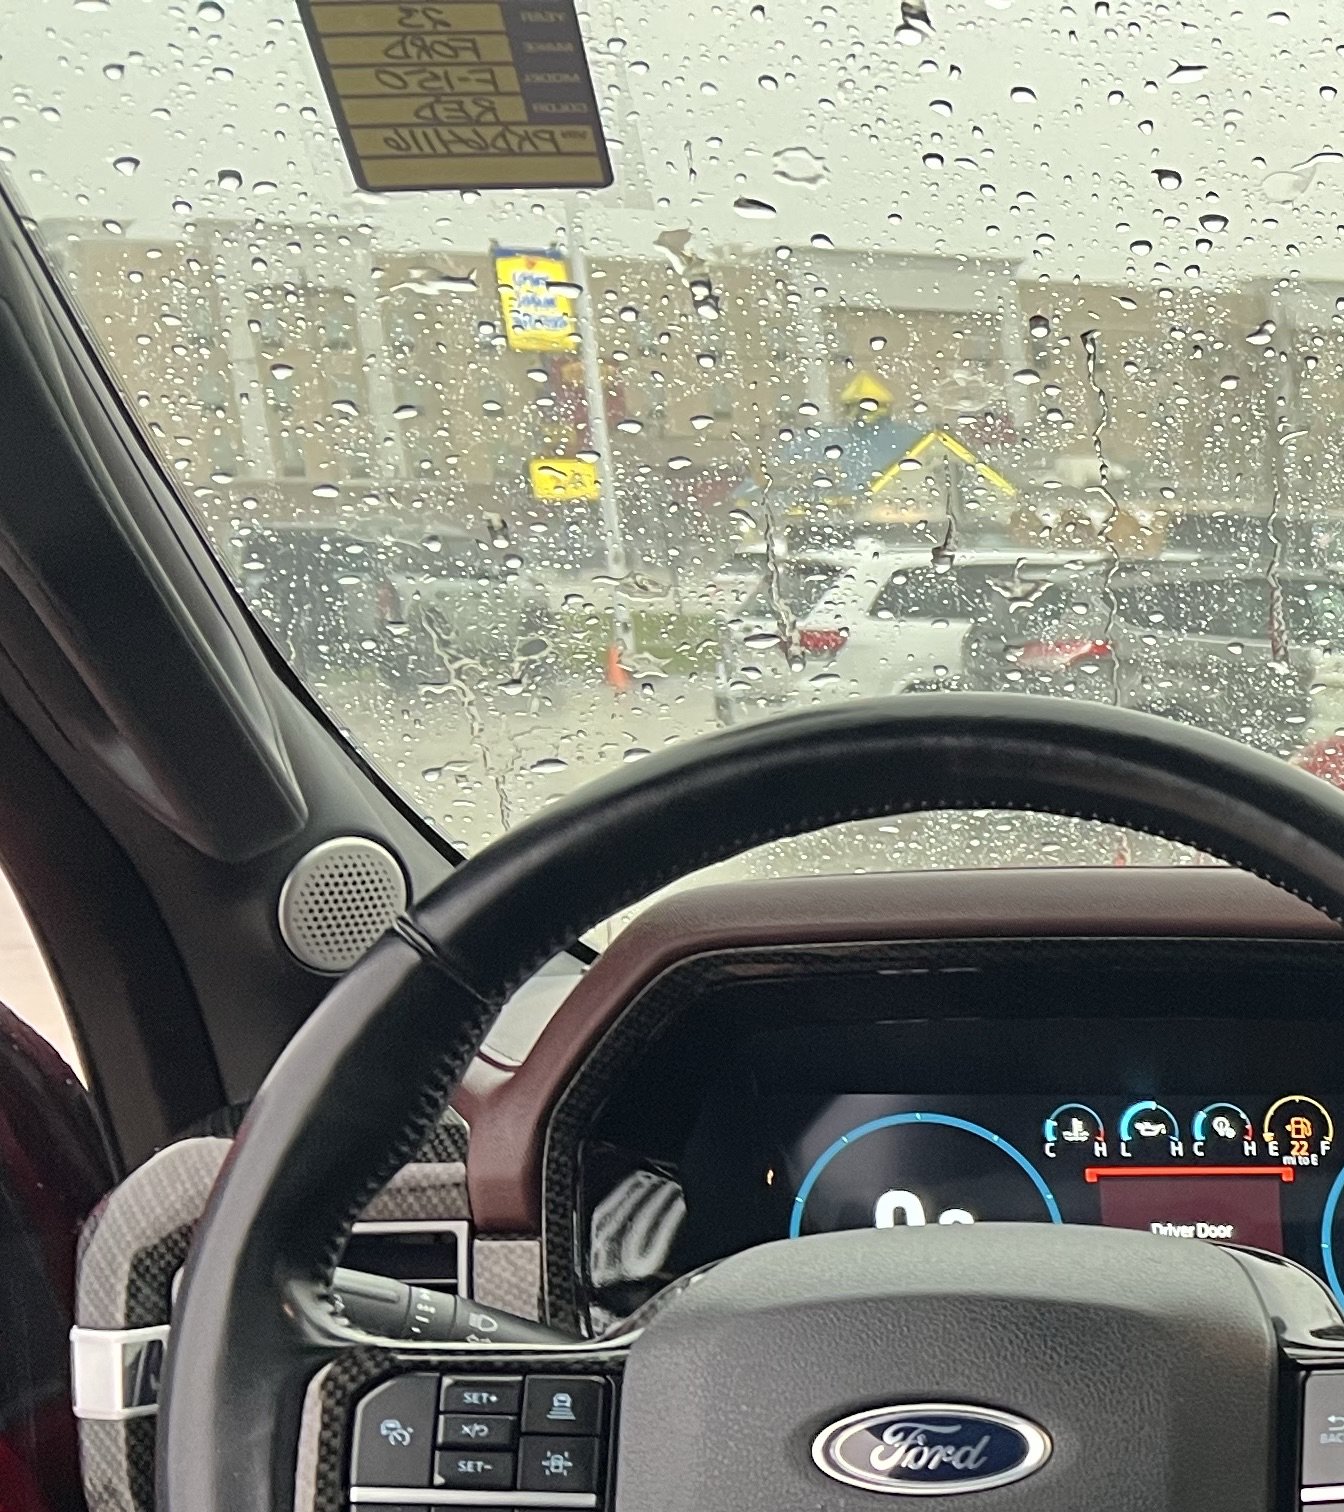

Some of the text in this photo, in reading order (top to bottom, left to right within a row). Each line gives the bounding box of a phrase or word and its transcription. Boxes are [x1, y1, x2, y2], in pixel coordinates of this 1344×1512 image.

[1044, 1142, 1057, 1158] C
[1094, 1142, 1108, 1158] H
[1120, 1141, 1132, 1157] L
[1170, 1141, 1184, 1157] H
[1192, 1141, 1205, 1157] C
[1243, 1141, 1258, 1157] H
[1268, 1141, 1280, 1157] E
[1290, 1140, 1310, 1156] 22
[1320, 1140, 1331, 1156] F
[1151, 1222, 1234, 1239] Driver Door
[869, 1422, 990, 1470] Ford
